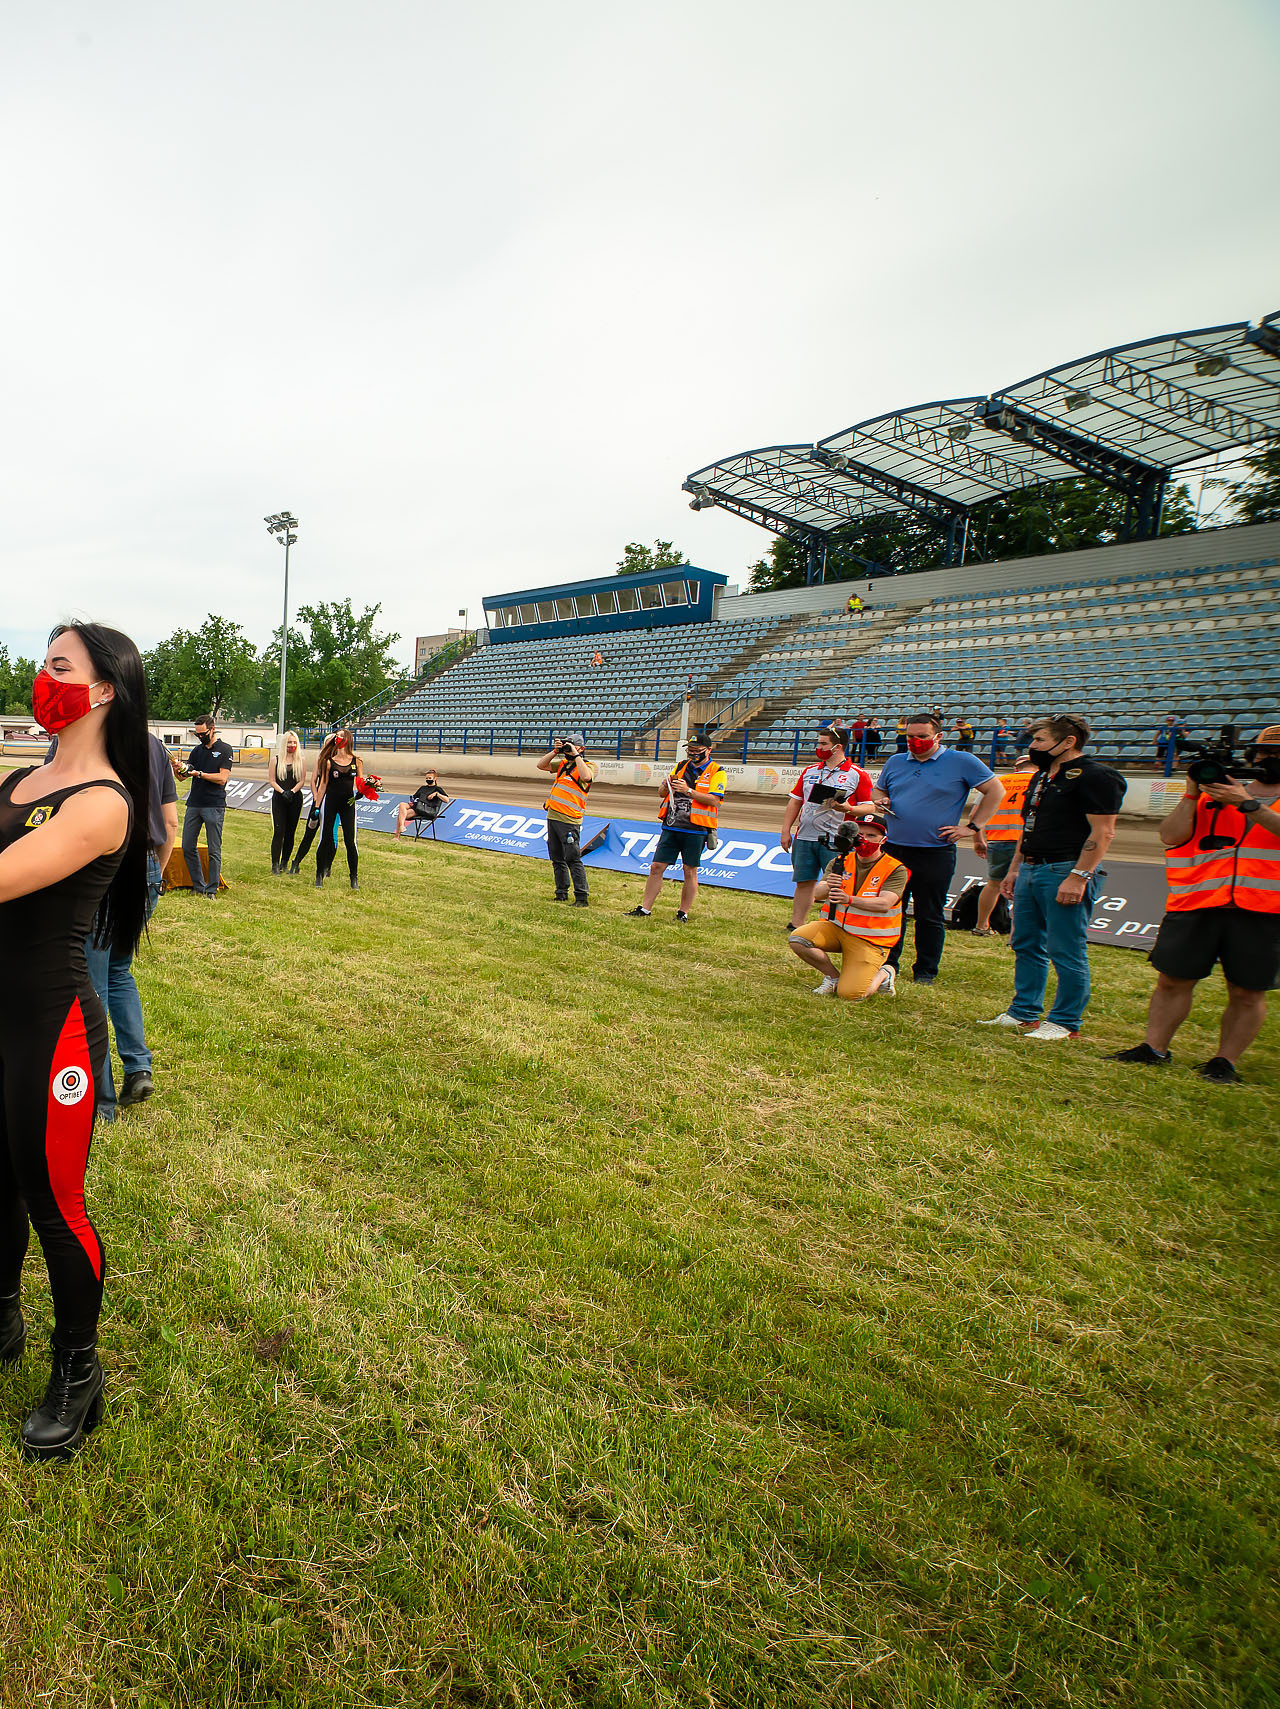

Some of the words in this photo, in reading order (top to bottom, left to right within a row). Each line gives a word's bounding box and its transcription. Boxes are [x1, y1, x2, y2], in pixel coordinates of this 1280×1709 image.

[1007, 792, 1018, 804] 4
[453, 808, 583, 842] TROD
[464, 832, 480, 840] CAR
[478, 834, 502, 844] PARTS
[500, 838, 530, 849] ONLINE
[696, 866, 738, 879] ONLINE
[59, 1090, 83, 1101] OPTIBET
